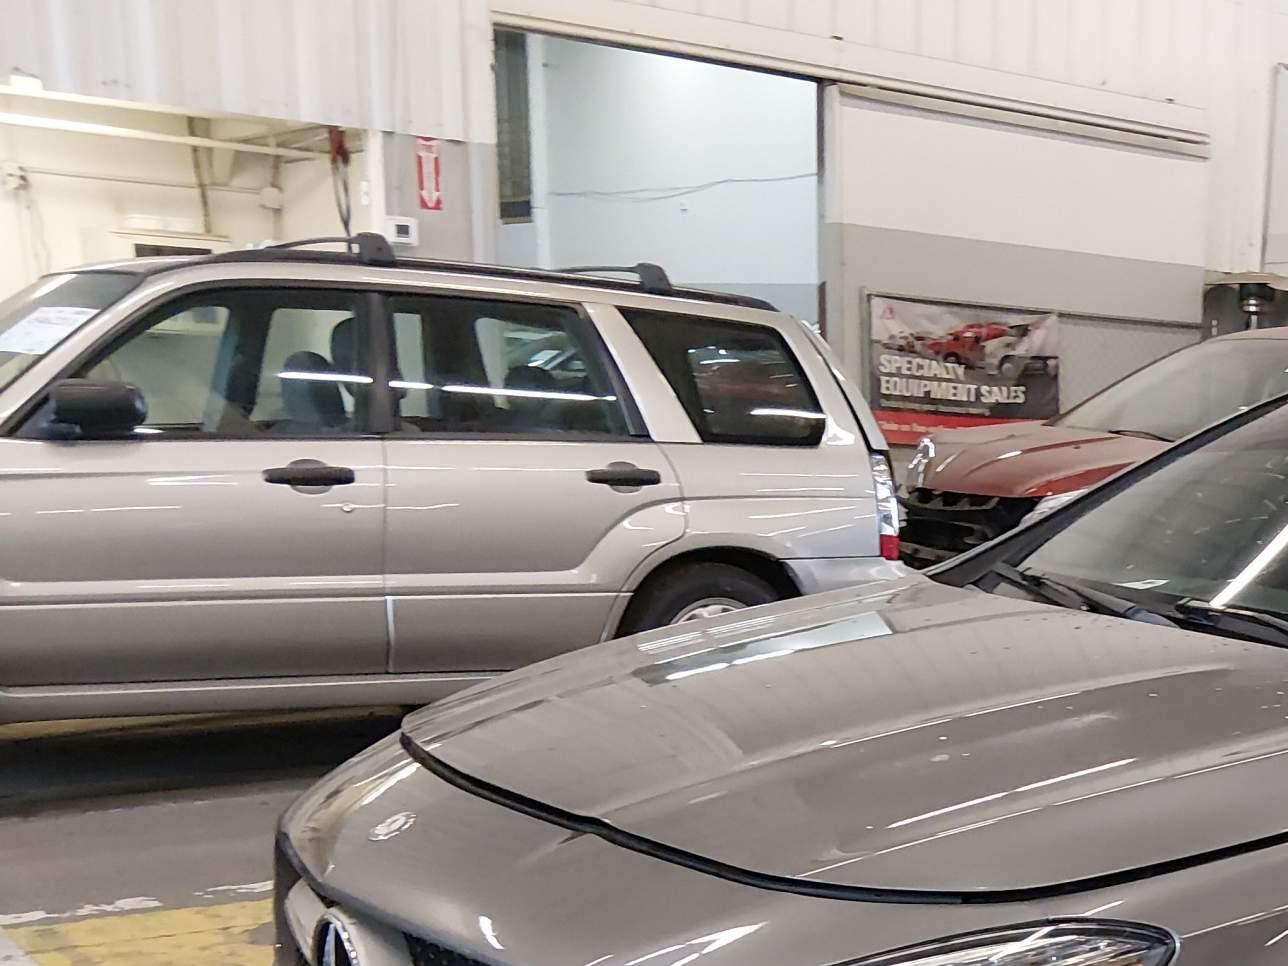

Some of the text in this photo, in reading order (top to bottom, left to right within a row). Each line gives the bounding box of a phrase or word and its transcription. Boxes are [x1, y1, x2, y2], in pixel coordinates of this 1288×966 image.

[879, 354, 966, 380] SPECIALTY
[880, 376, 1026, 404] EQUIPMENT SALES
